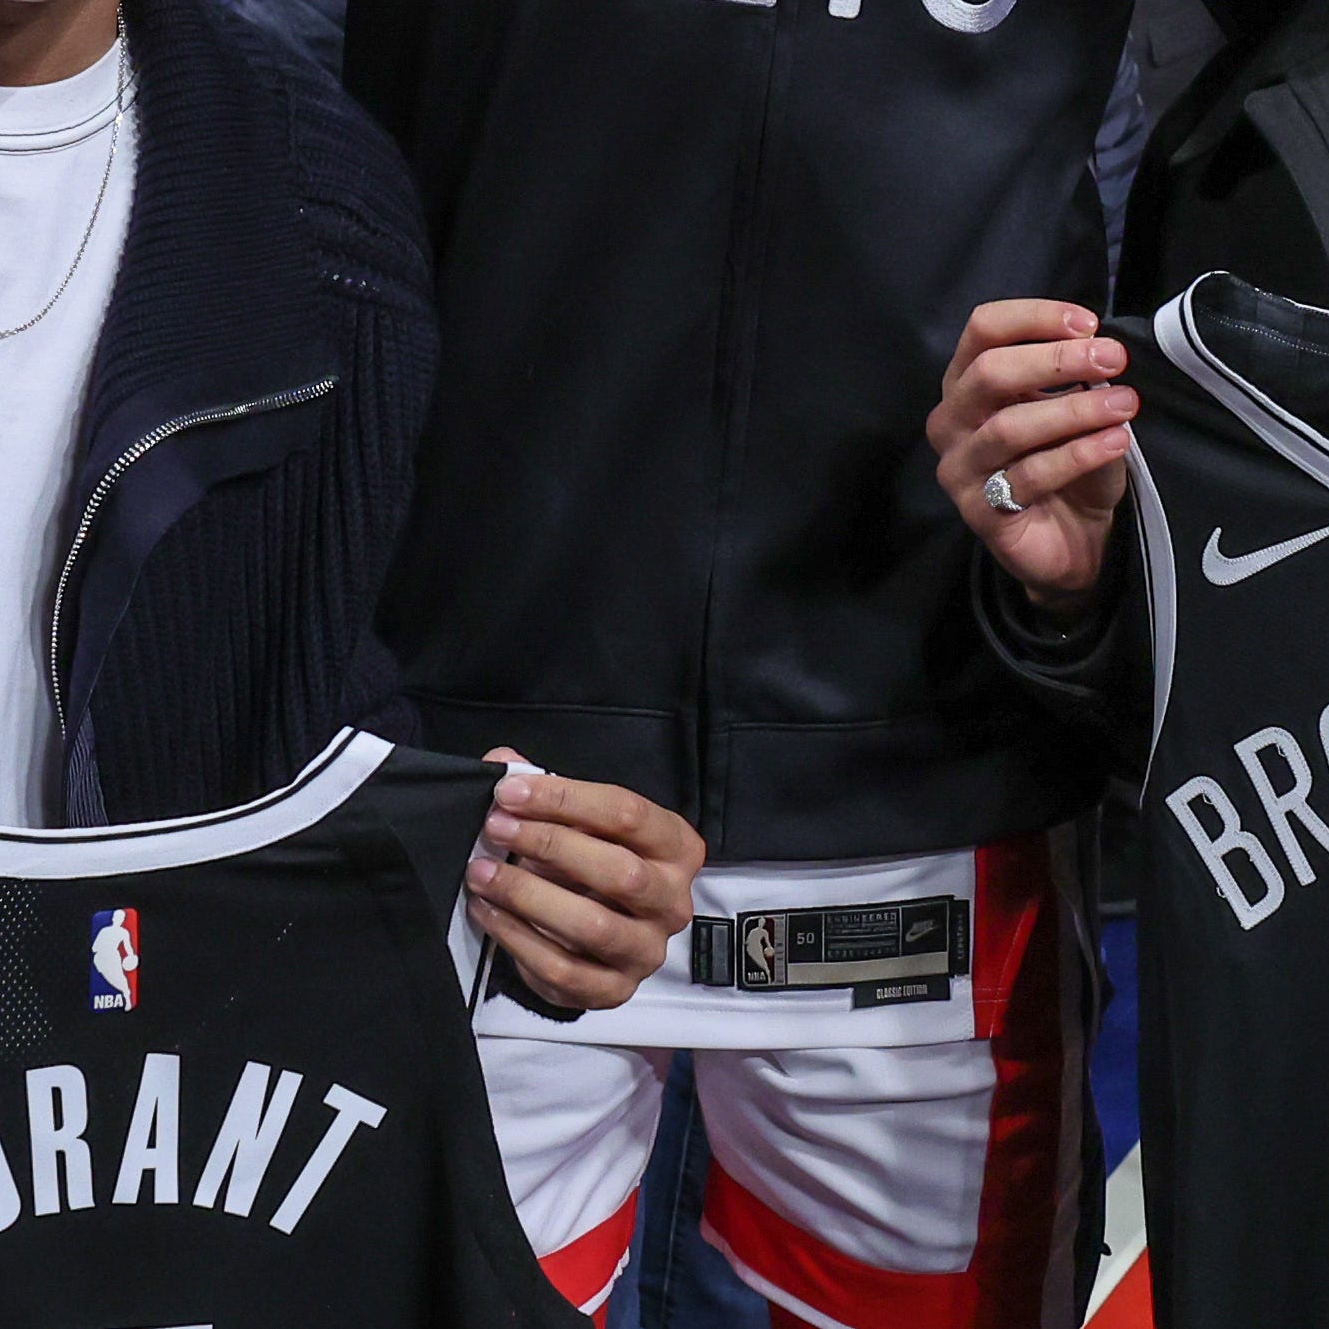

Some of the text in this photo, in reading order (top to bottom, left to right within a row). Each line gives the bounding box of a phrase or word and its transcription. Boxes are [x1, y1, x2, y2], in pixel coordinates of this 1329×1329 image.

[797, 932, 815, 945] 50
[876, 986, 902, 1000] CLASSIC
[94, 994, 124, 1009] NBA
